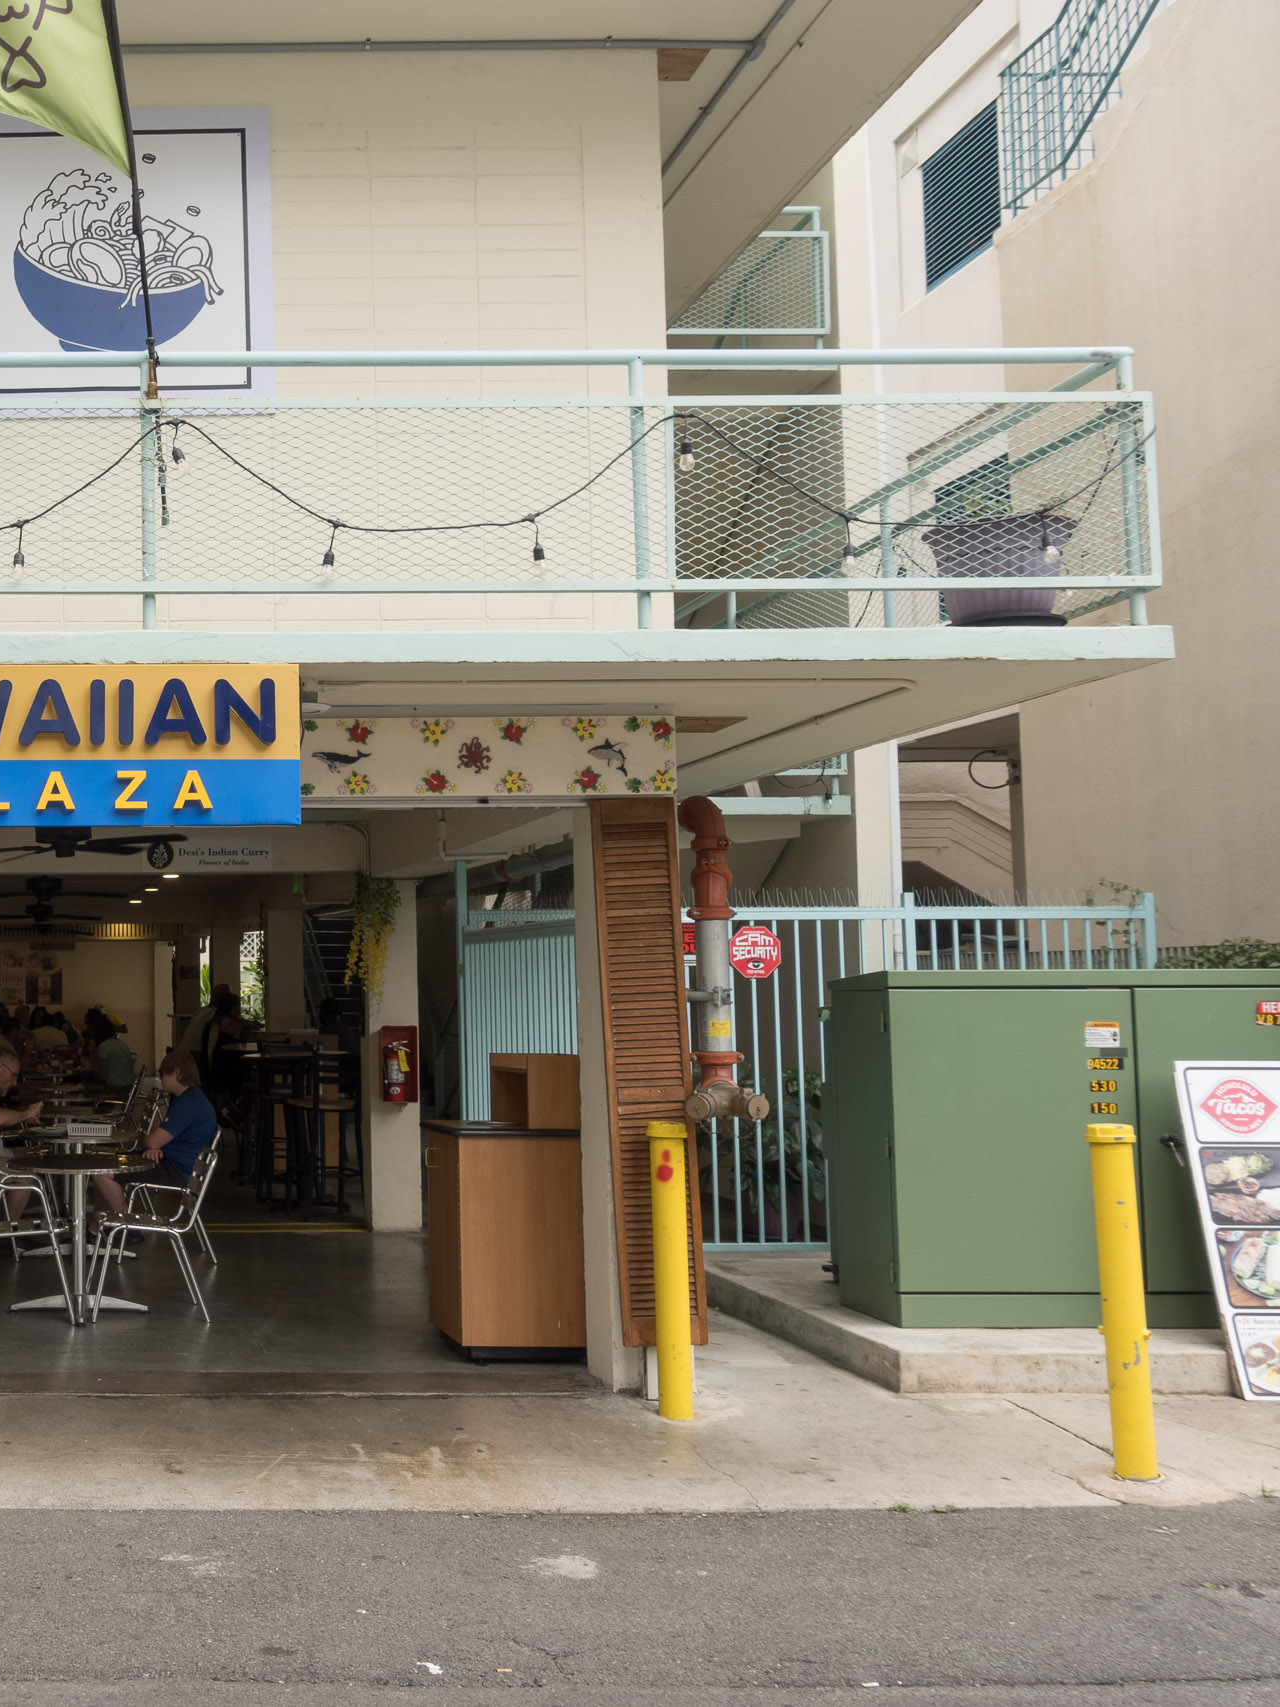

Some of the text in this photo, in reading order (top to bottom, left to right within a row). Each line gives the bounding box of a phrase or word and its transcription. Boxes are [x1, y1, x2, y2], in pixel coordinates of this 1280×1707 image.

[178, 847, 269, 858] Desi's Indian Curry
[736, 934, 773, 945] CAM
[732, 946, 777, 961] SECURITY
[1088, 1058, 1119, 1070] 94522
[1091, 1080, 1117, 1091] 530
[1092, 1103, 1117, 1114] 150
[1208, 1098, 1265, 1116] Tacos
